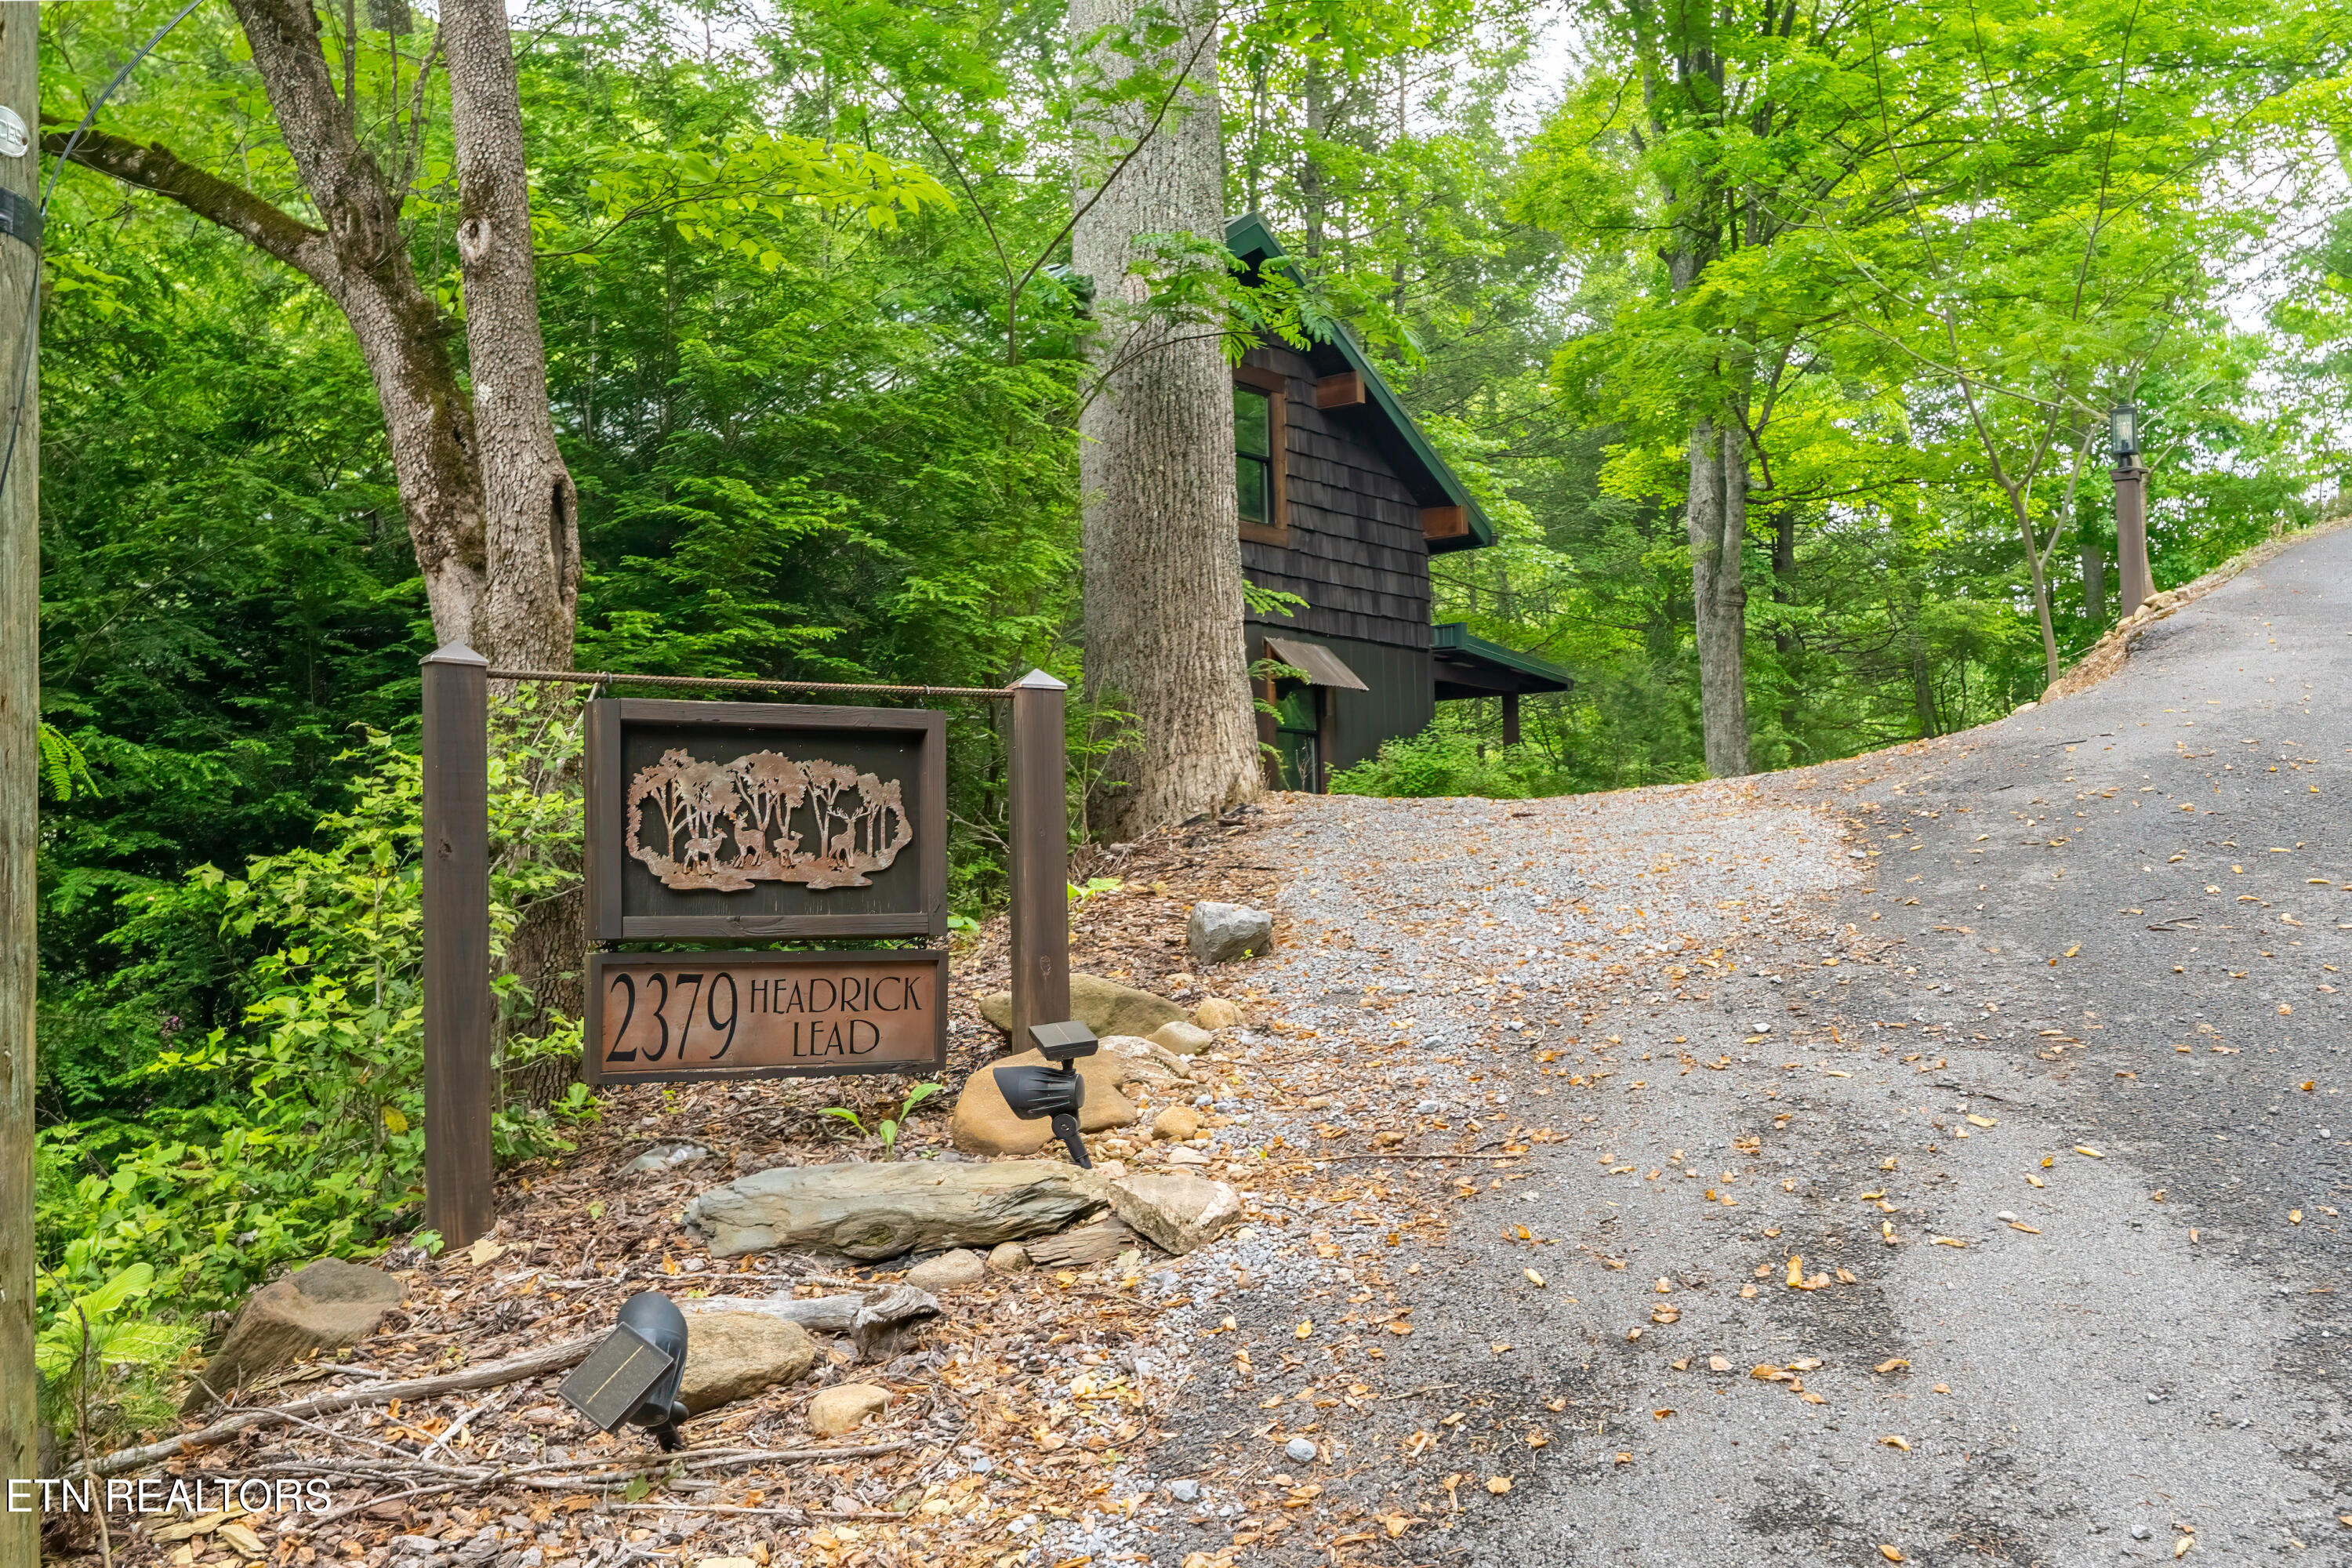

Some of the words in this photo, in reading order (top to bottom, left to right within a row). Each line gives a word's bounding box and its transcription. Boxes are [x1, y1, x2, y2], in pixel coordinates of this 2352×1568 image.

[606, 971, 738, 1062] 2379
[750, 976, 922, 1014] HEADRICK
[792, 1019, 880, 1057] LEAD
